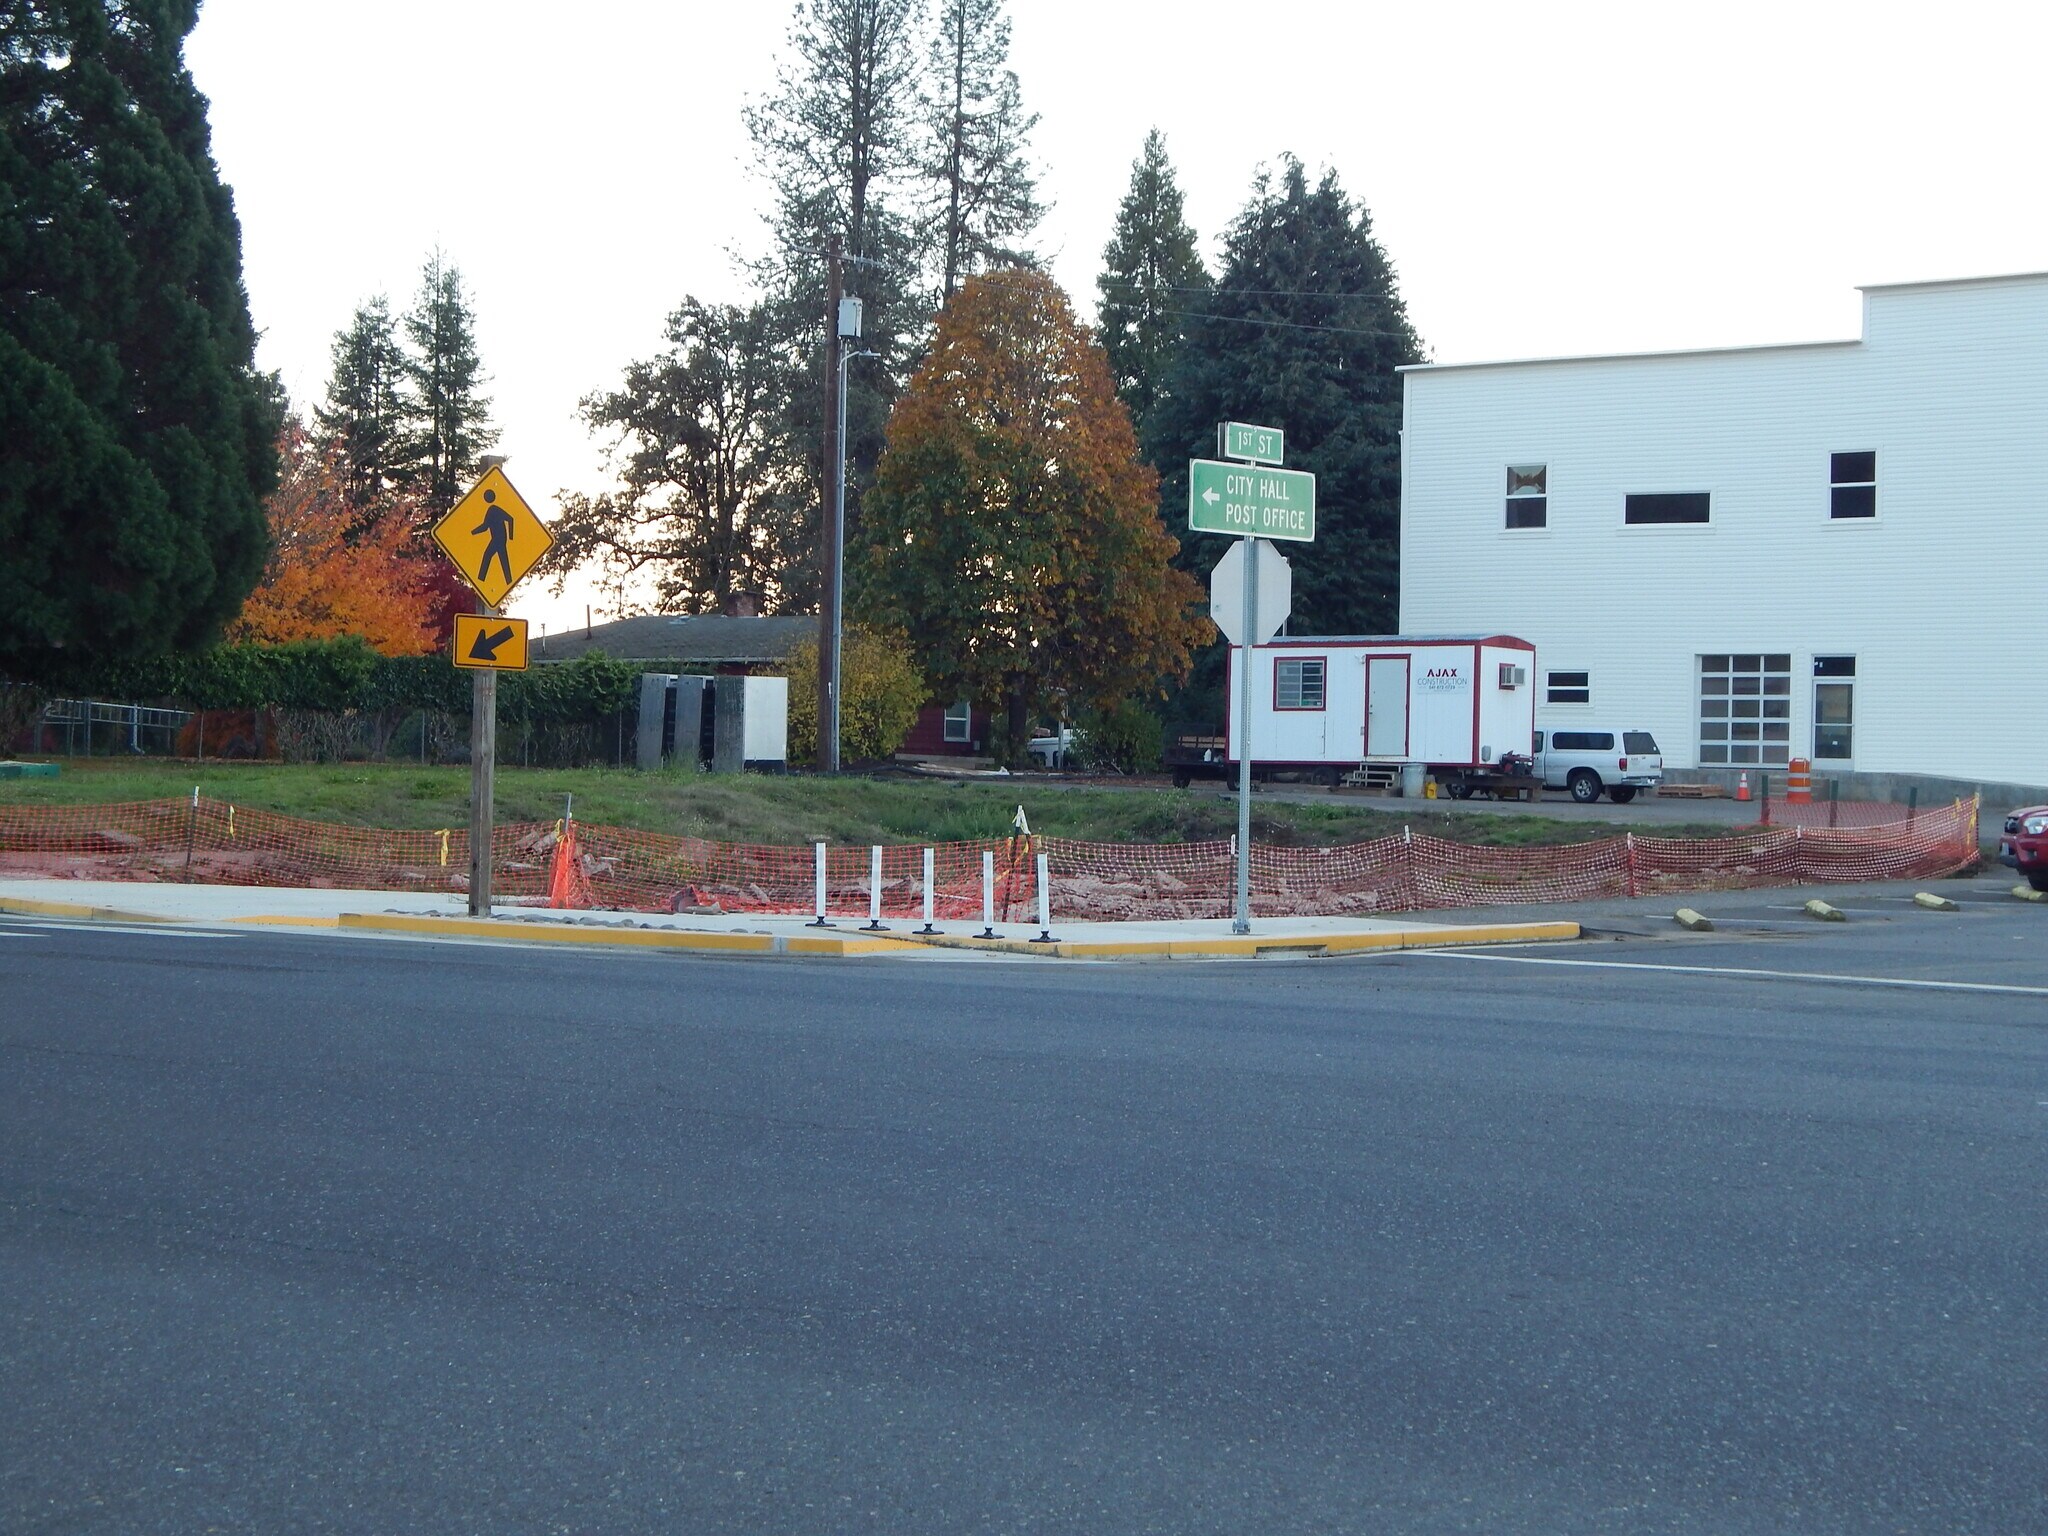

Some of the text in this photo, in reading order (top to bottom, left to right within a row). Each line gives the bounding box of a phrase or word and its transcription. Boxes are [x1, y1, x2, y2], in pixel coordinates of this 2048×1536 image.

[1238, 431, 1273, 455] 1ST ST
[1226, 474, 1290, 500] CITY HALL
[1226, 503, 1306, 530] POST OFFICE
[1427, 668, 1457, 677] AJAX
